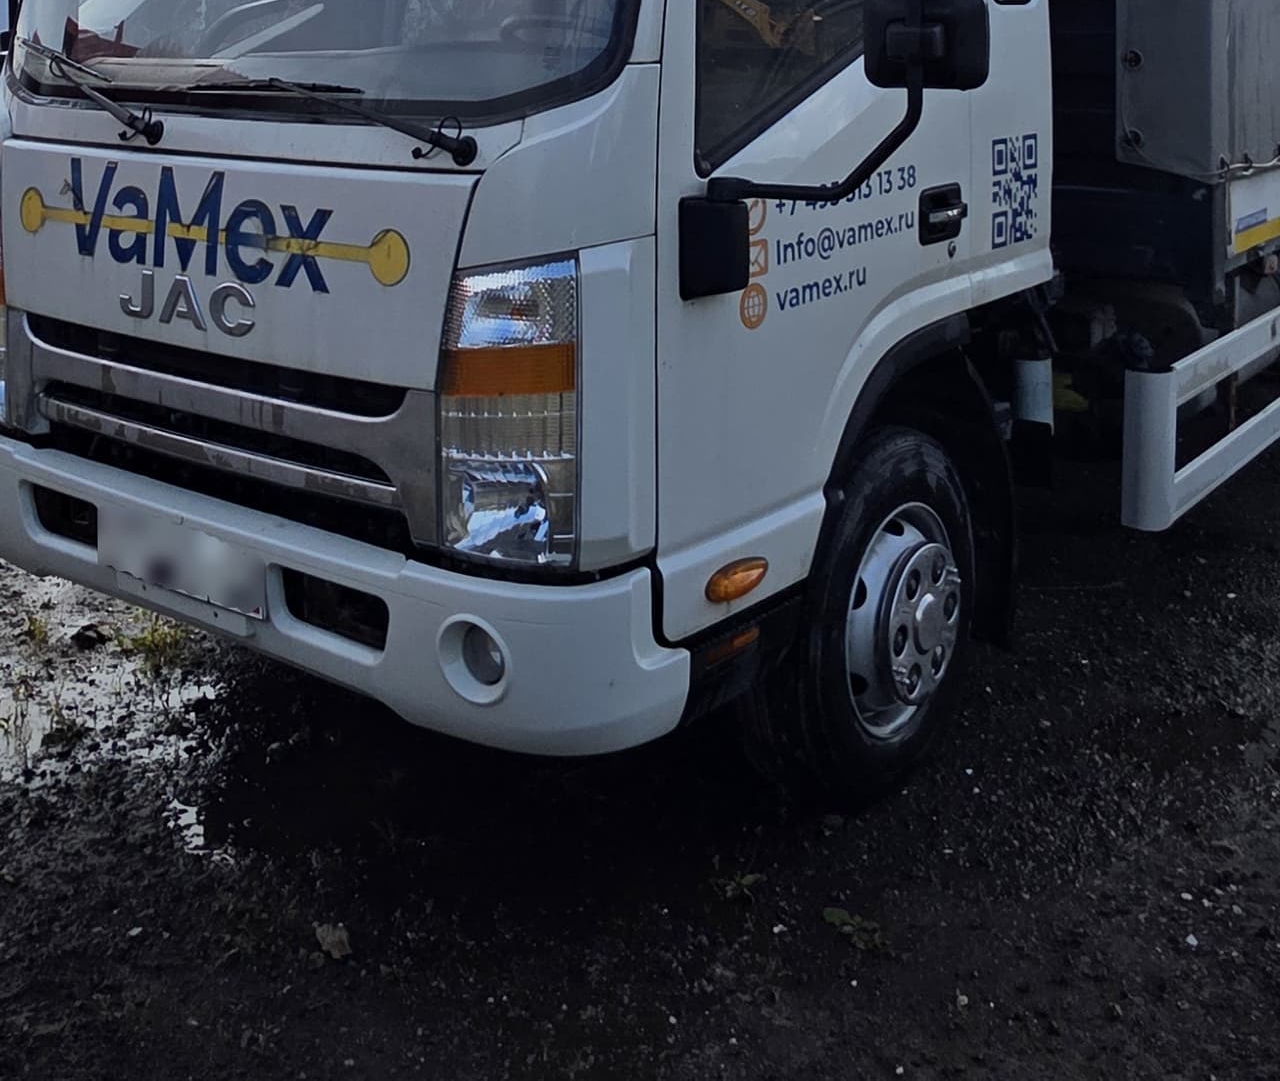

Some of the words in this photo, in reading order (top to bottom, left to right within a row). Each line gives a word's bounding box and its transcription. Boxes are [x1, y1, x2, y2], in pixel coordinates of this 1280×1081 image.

[877, 169, 893, 196] 13
[897, 164, 917, 191] 38
[71, 157, 333, 294] VaMex
[775, 211, 915, 266] Info@vamex.ru
[120, 269, 256, 338] JAC
[775, 267, 867, 312] vamex.ru
